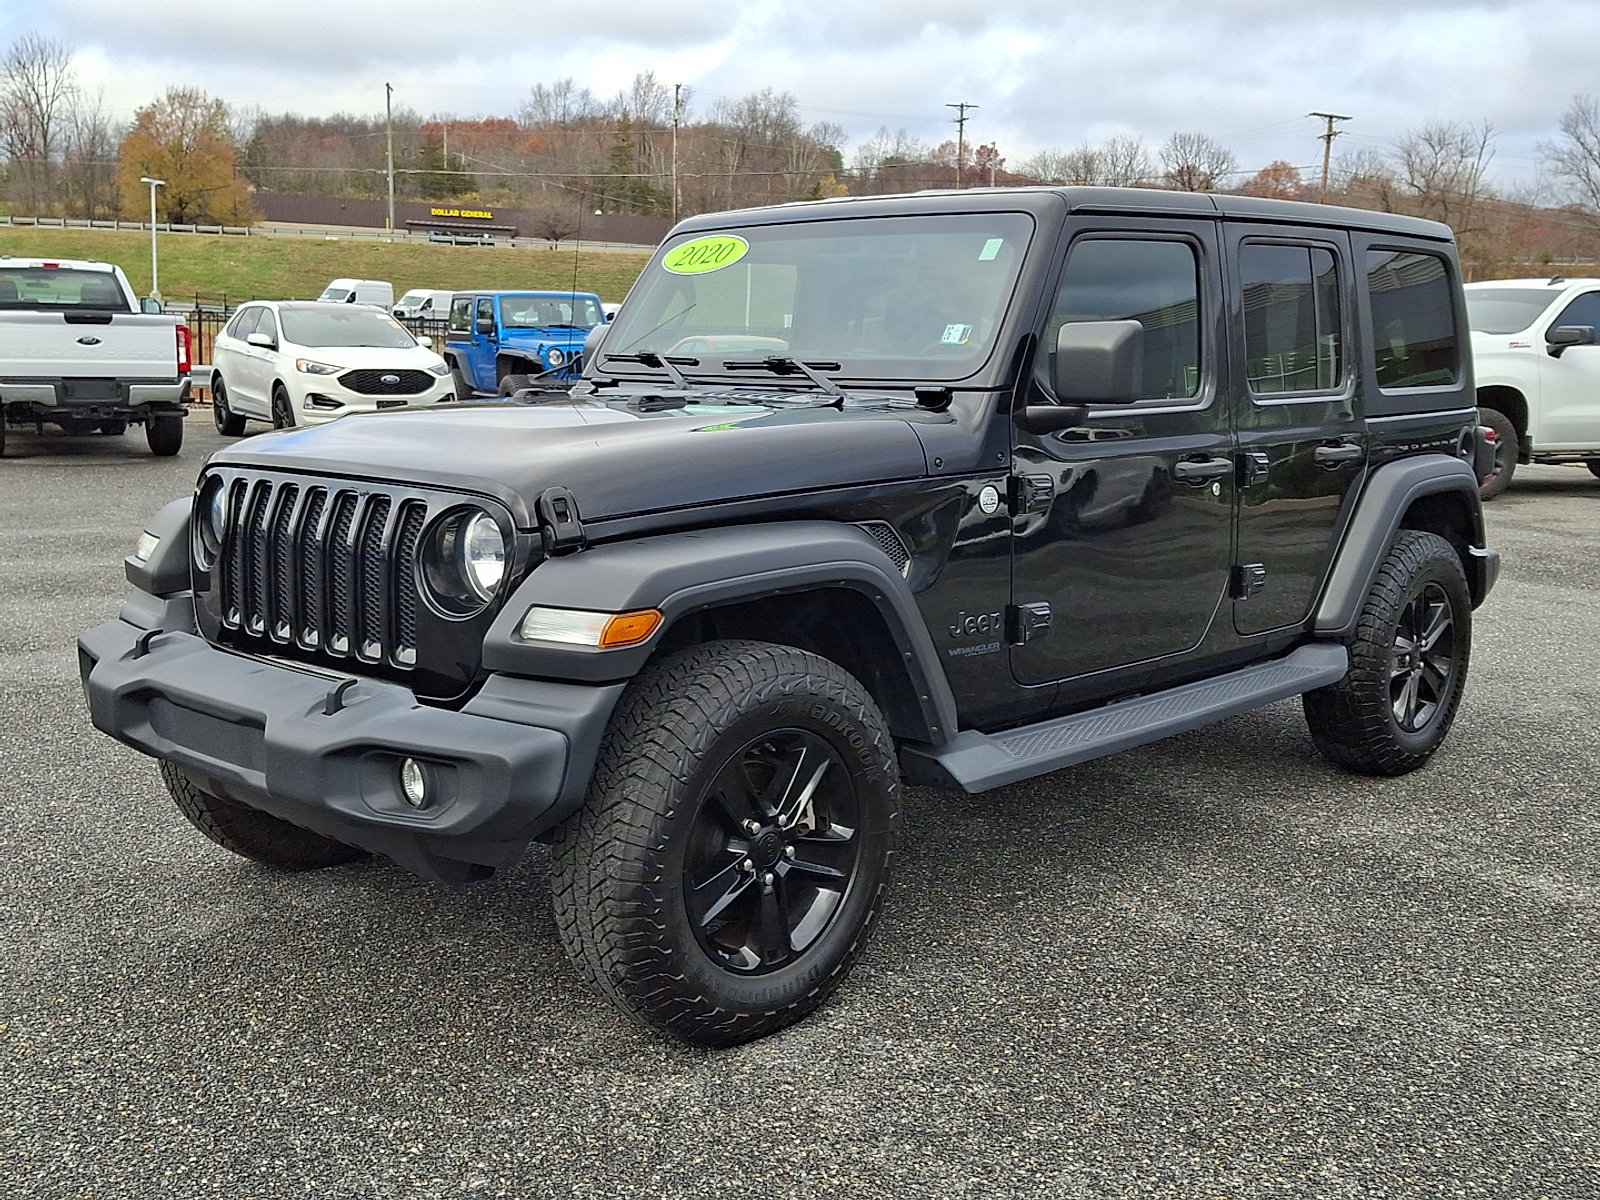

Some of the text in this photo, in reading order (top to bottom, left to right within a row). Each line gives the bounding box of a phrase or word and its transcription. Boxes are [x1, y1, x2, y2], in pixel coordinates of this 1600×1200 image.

[431, 208, 493, 219] DOLLAR GENERAL
[673, 242, 736, 267] 2020
[949, 610, 1000, 638] Jeep
[948, 642, 1000, 656] WRANGLER
